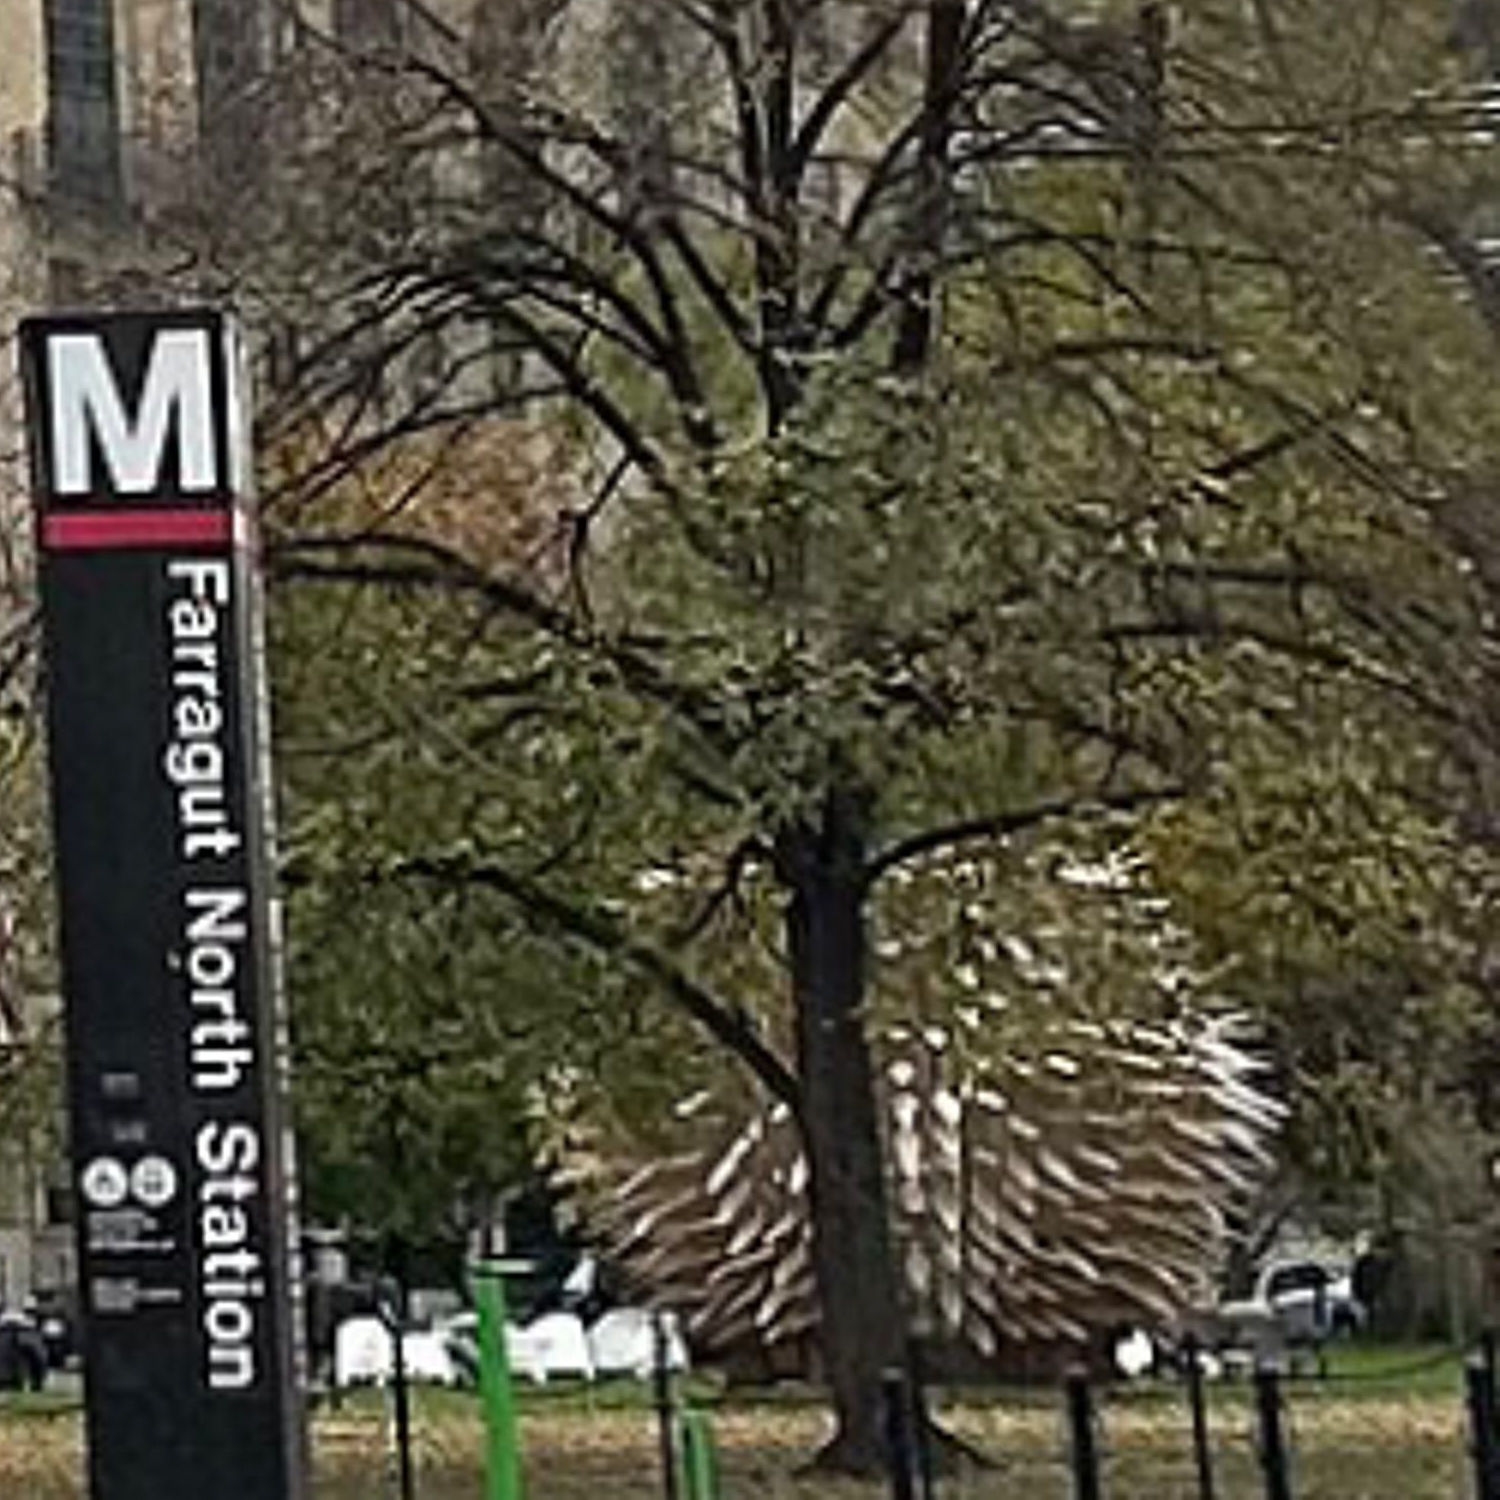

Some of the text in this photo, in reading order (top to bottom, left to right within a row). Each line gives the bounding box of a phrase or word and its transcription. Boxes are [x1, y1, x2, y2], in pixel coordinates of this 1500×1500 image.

[47, 328, 217, 494] M
[165, 561, 264, 1388] Farragut North Station
